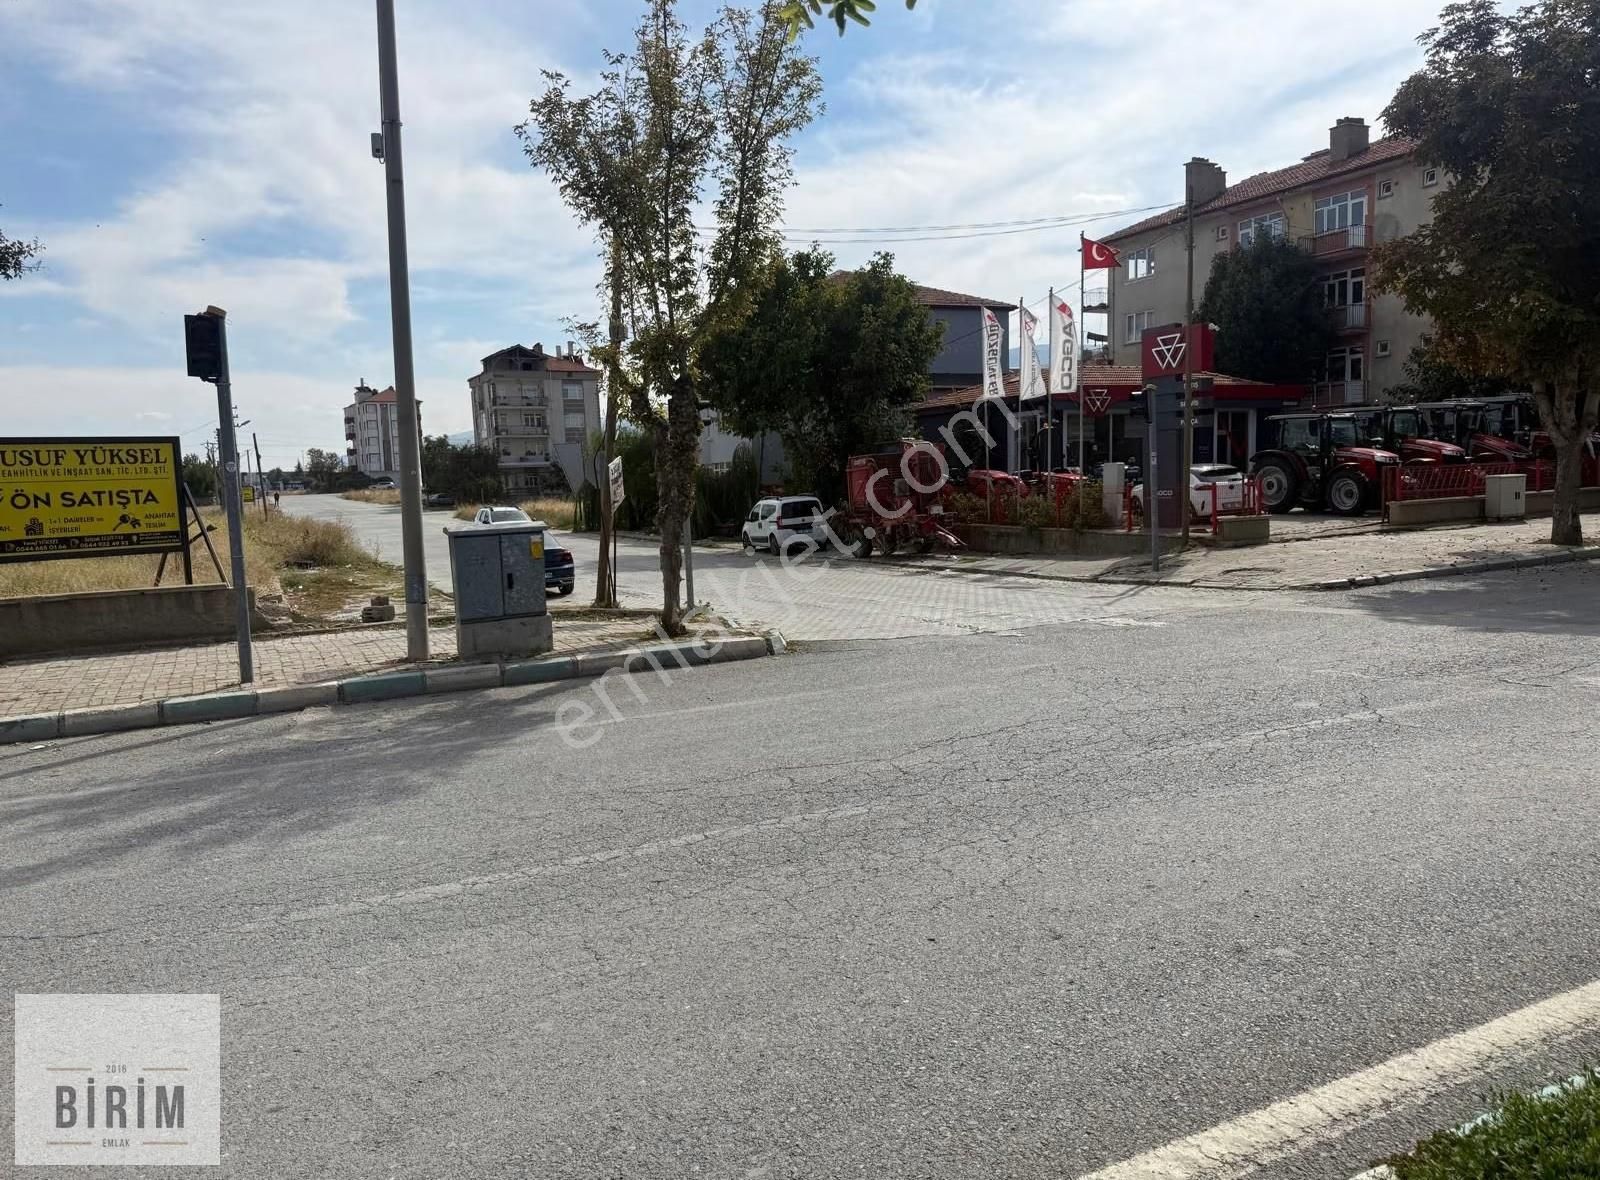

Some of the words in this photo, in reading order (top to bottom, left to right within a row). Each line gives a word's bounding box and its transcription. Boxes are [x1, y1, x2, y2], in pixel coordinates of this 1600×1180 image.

[73, 446, 168, 466] YÜKSEL
[50, 468, 61, 477] VE
[10, 489, 51, 510] ÖN
[60, 489, 159, 510] SATIŞTA
